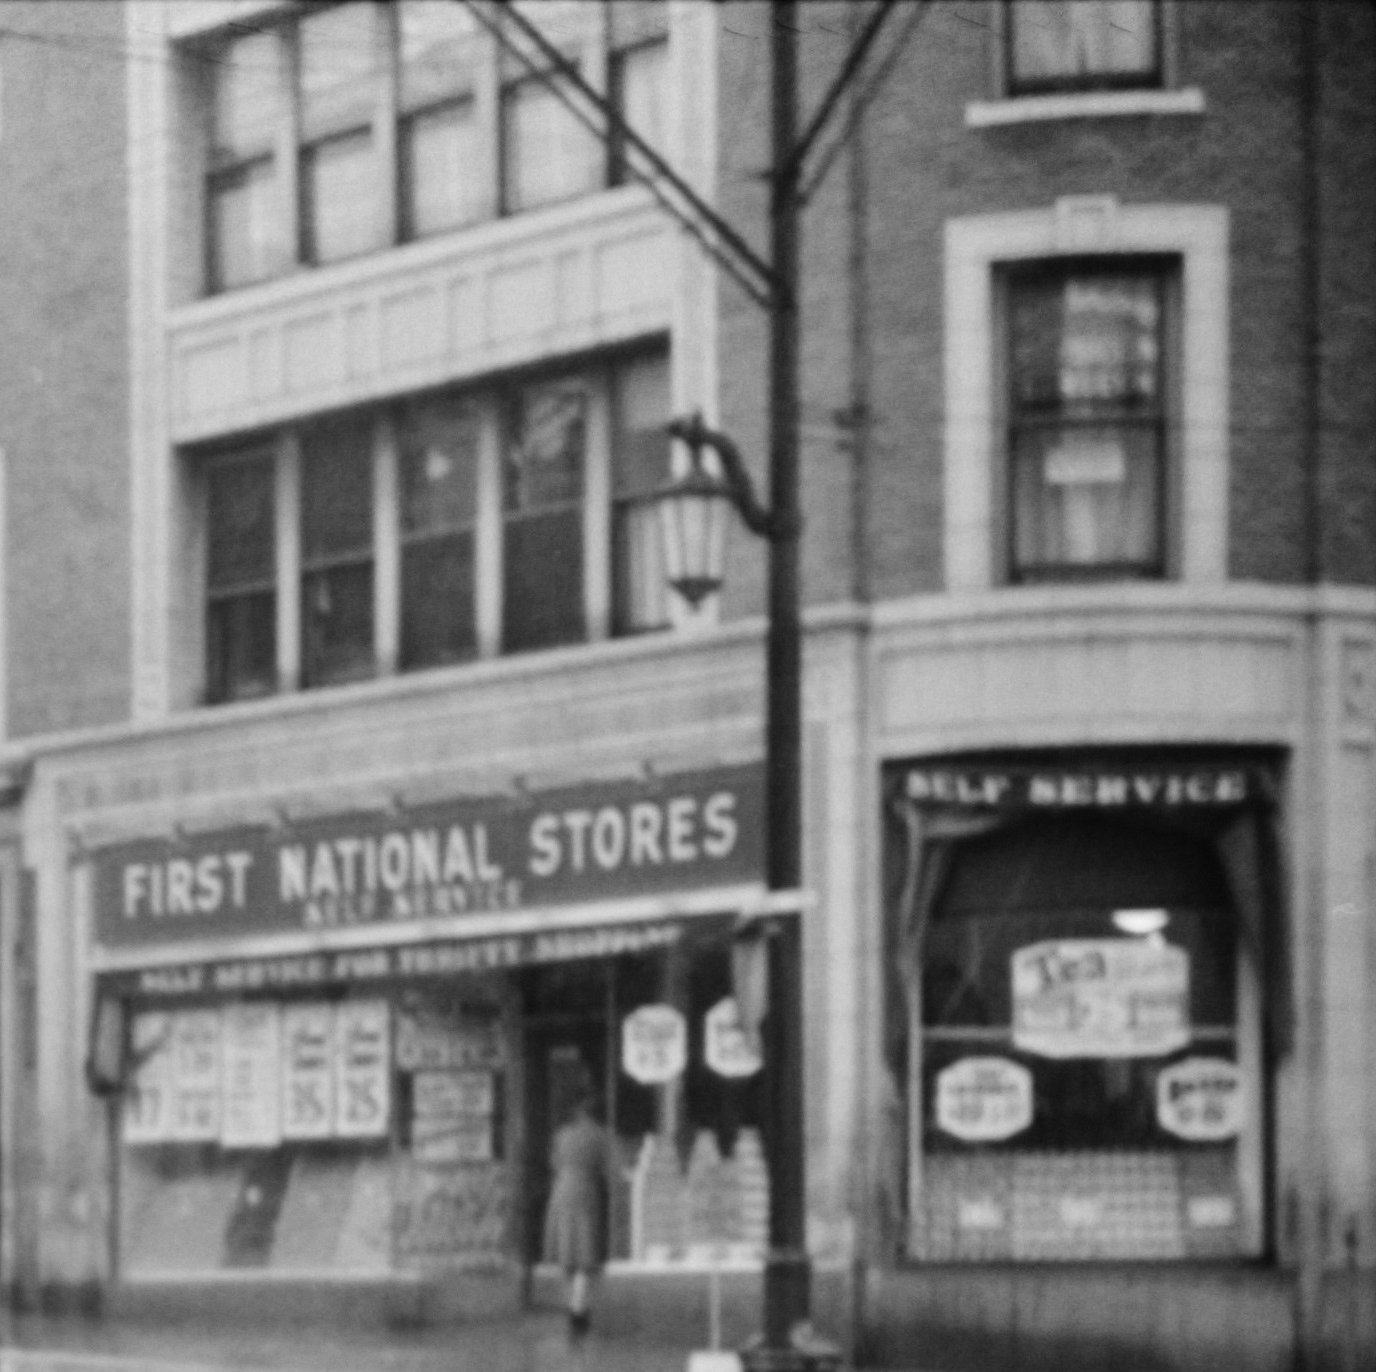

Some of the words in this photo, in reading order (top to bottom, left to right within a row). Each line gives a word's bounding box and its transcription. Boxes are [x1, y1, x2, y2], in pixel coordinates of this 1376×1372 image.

[906, 769, 1009, 804] SELF
[1030, 773, 1246, 805] SERVICE
[123, 851, 253, 918] FIRST
[278, 822, 503, 902] NATIONAL
[529, 792, 739, 877] STORES
